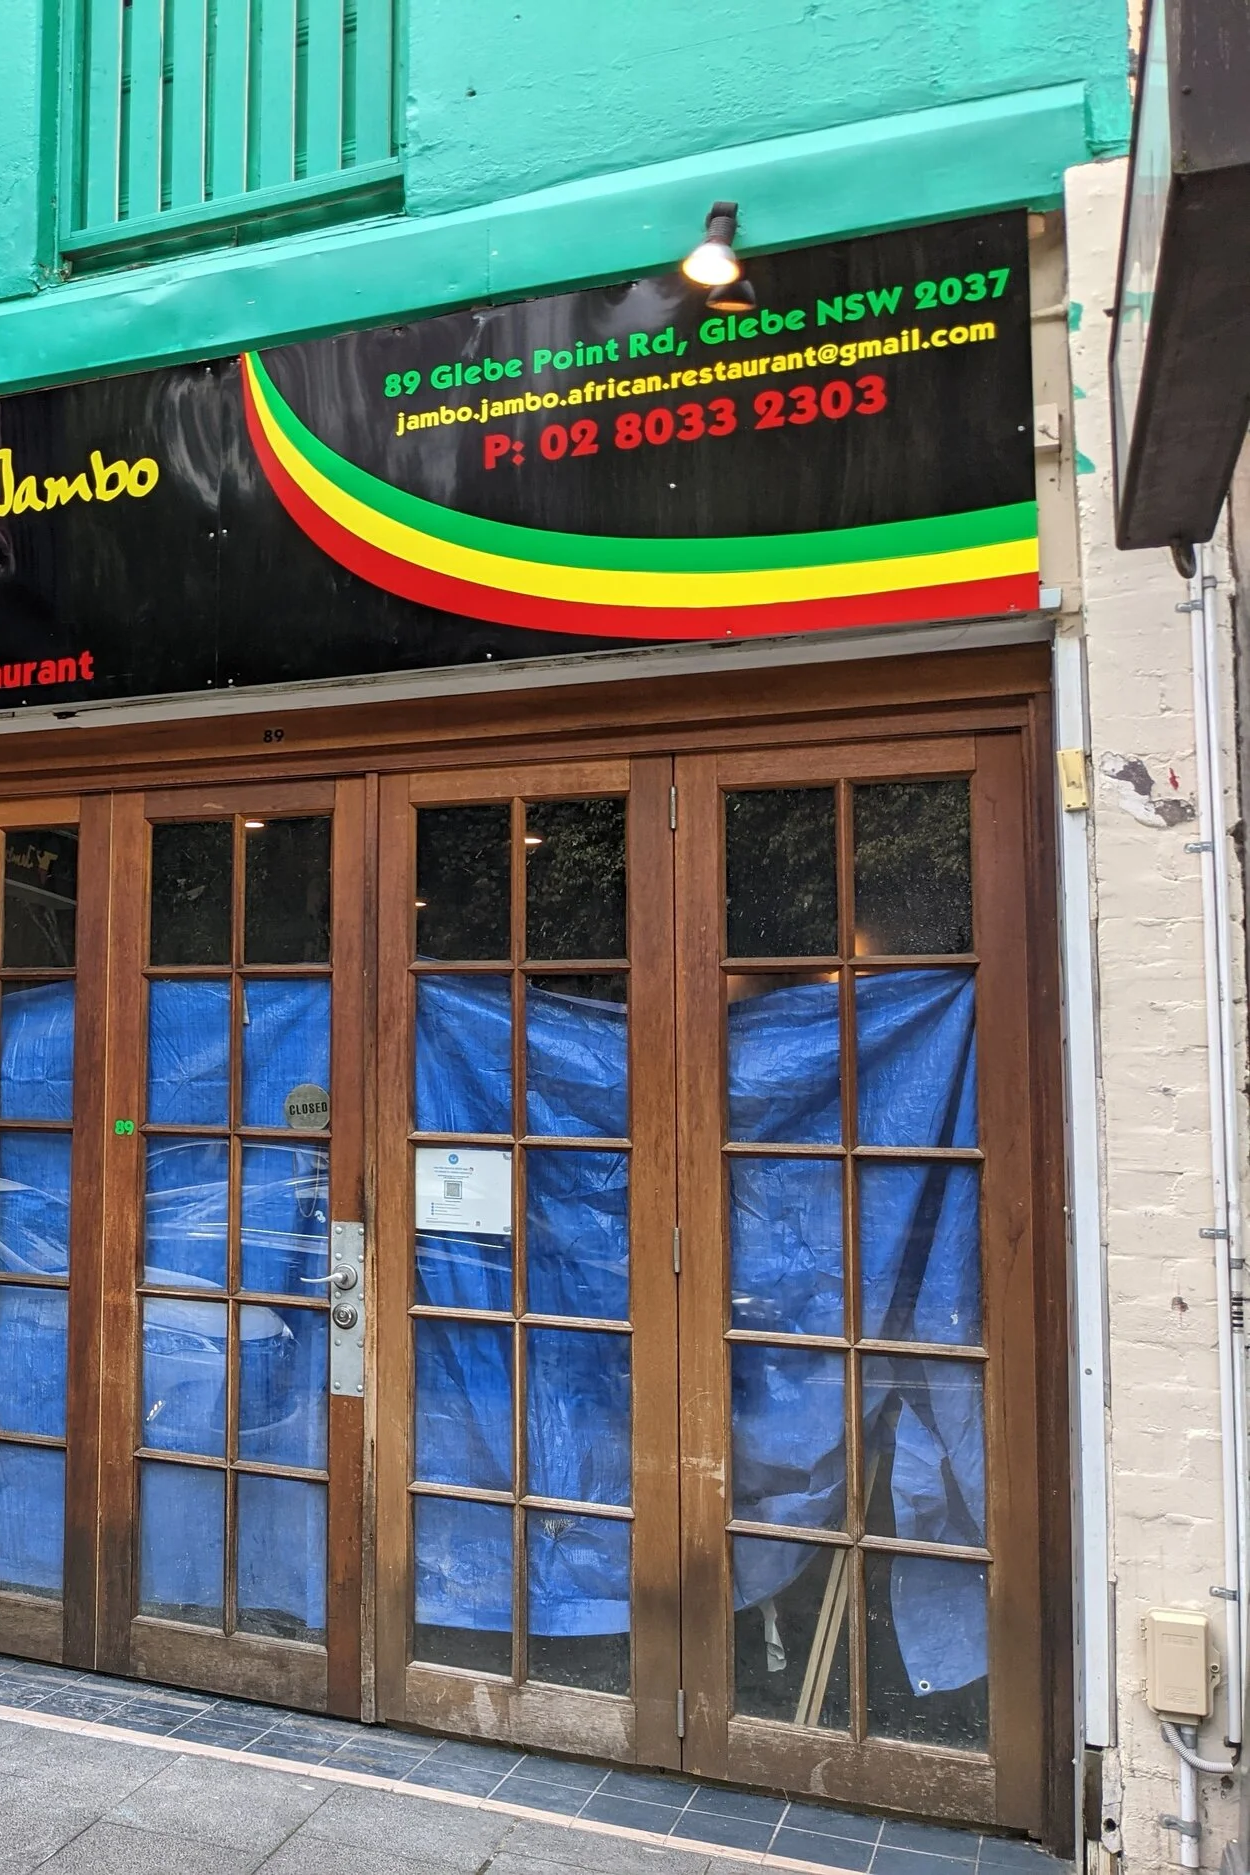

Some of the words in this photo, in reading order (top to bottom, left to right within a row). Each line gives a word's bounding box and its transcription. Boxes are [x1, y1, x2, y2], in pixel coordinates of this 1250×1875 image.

[383, 369, 421, 397] 89
[430, 356, 523, 390] Glebe
[532, 337, 620, 374] Point
[628, 326, 688, 358] Rd,
[699, 308, 806, 345] Glebe
[817, 285, 902, 326] NSW
[914, 267, 1011, 309] 2037
[395, 321, 997, 437] jambo.jambo.african.restaurant@gmail.com
[482, 432, 525, 471] P:
[538, 419, 599, 461] 02
[614, 396, 738, 451] 8033
[753, 374, 888, 430] 2303
[263, 729, 285, 743] 89
[114, 1119, 135, 1136] 89
[289, 1101, 328, 1116] CLOSED
